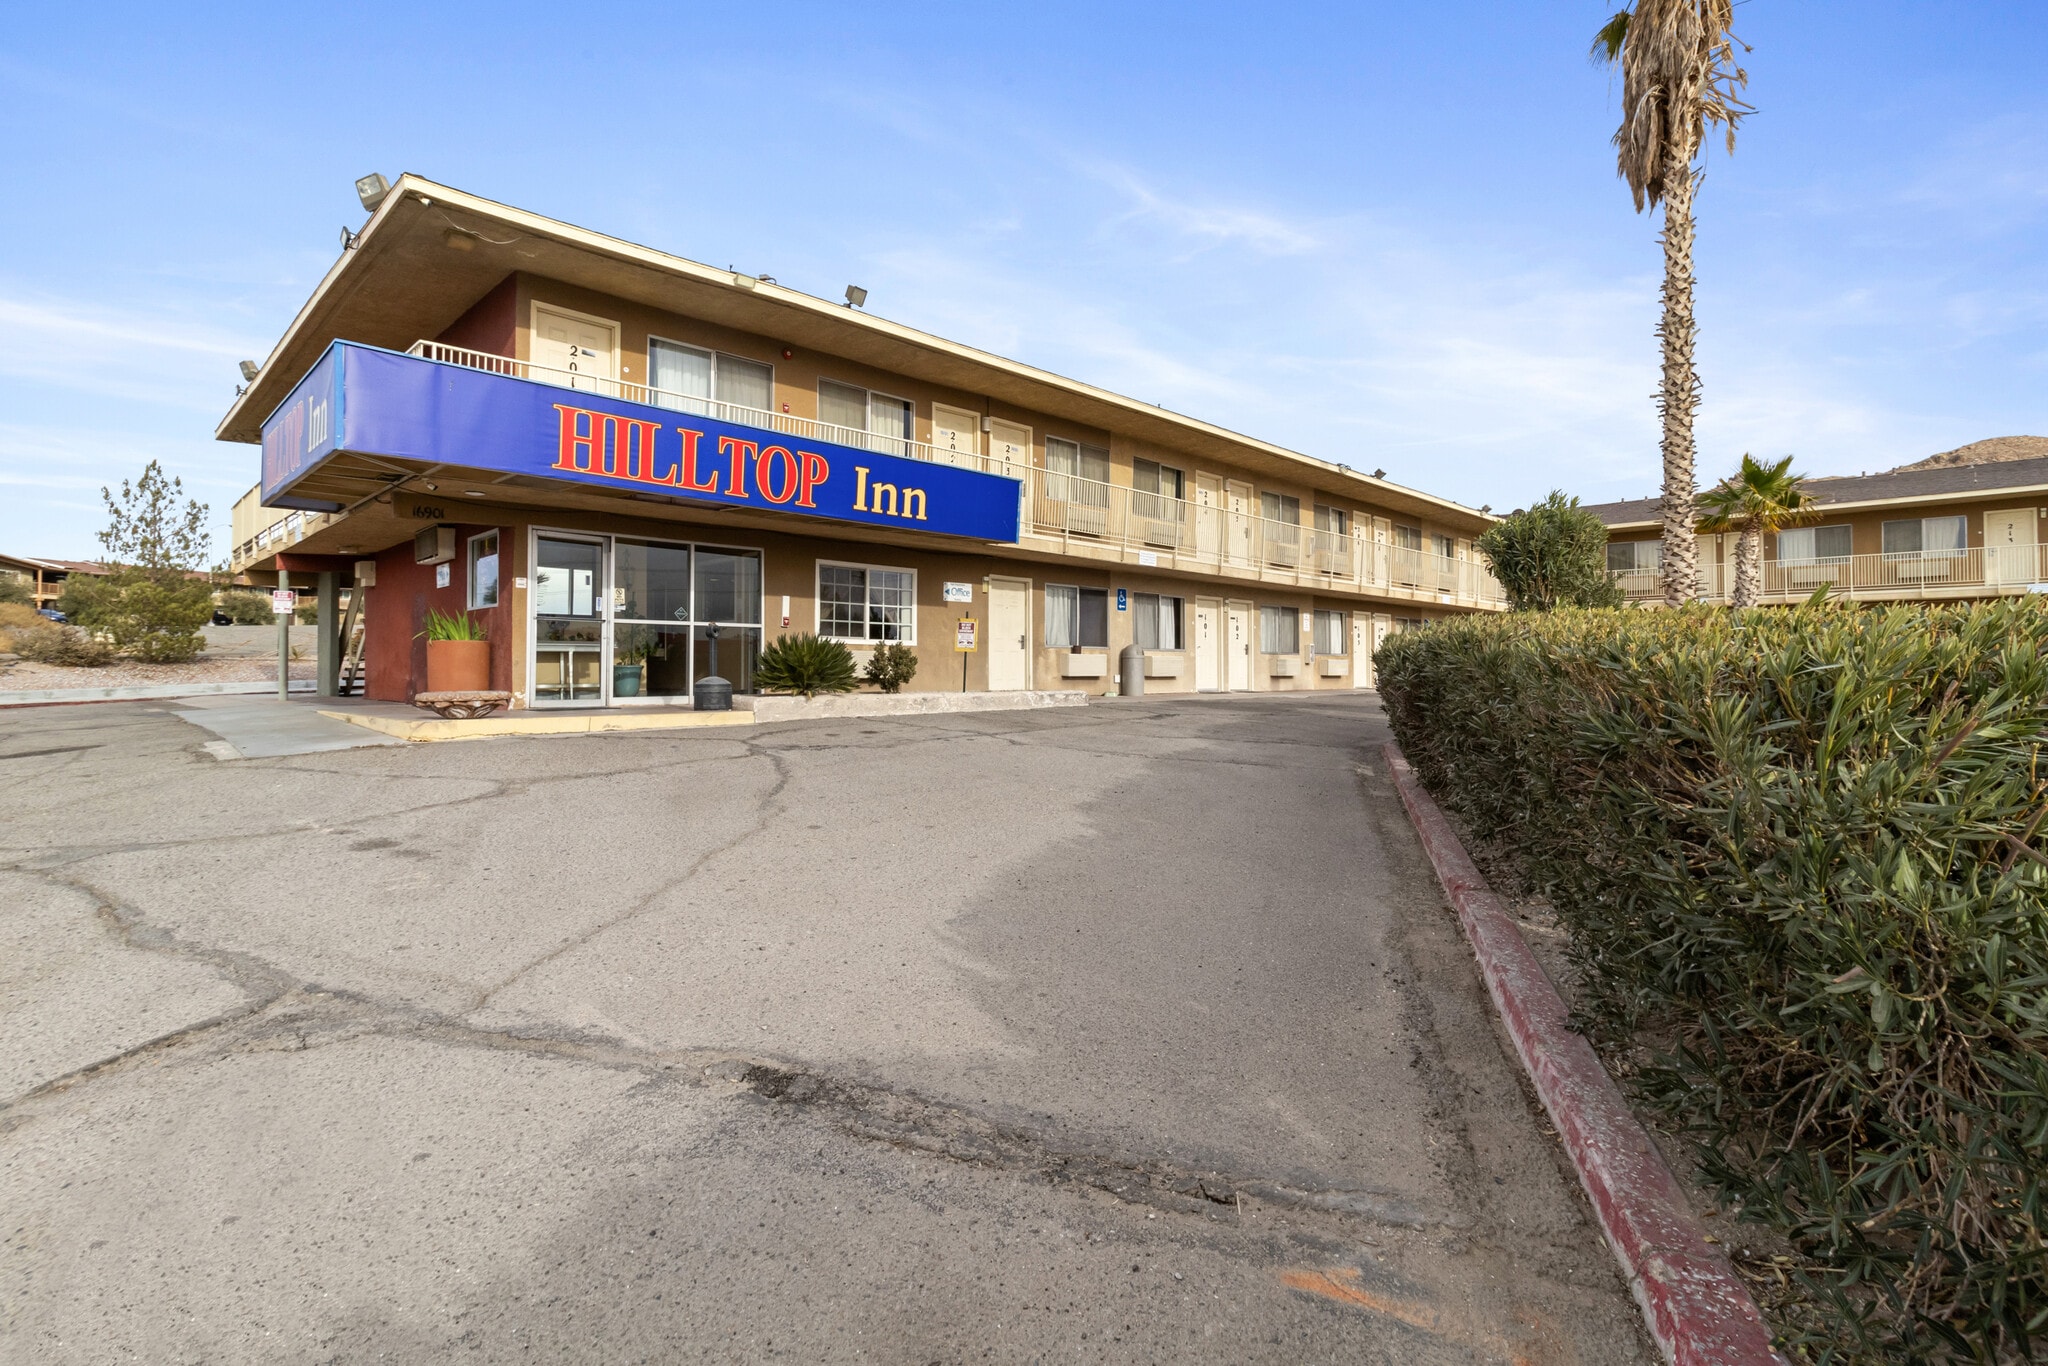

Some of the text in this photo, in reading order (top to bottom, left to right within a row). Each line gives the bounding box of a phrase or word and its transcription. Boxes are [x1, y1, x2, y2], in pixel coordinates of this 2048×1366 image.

[308, 395, 328, 453] Inn
[551, 403, 929, 521] HILLTOP Inn
[412, 505, 445, 519] 16901
[951, 587, 970, 597] Office
